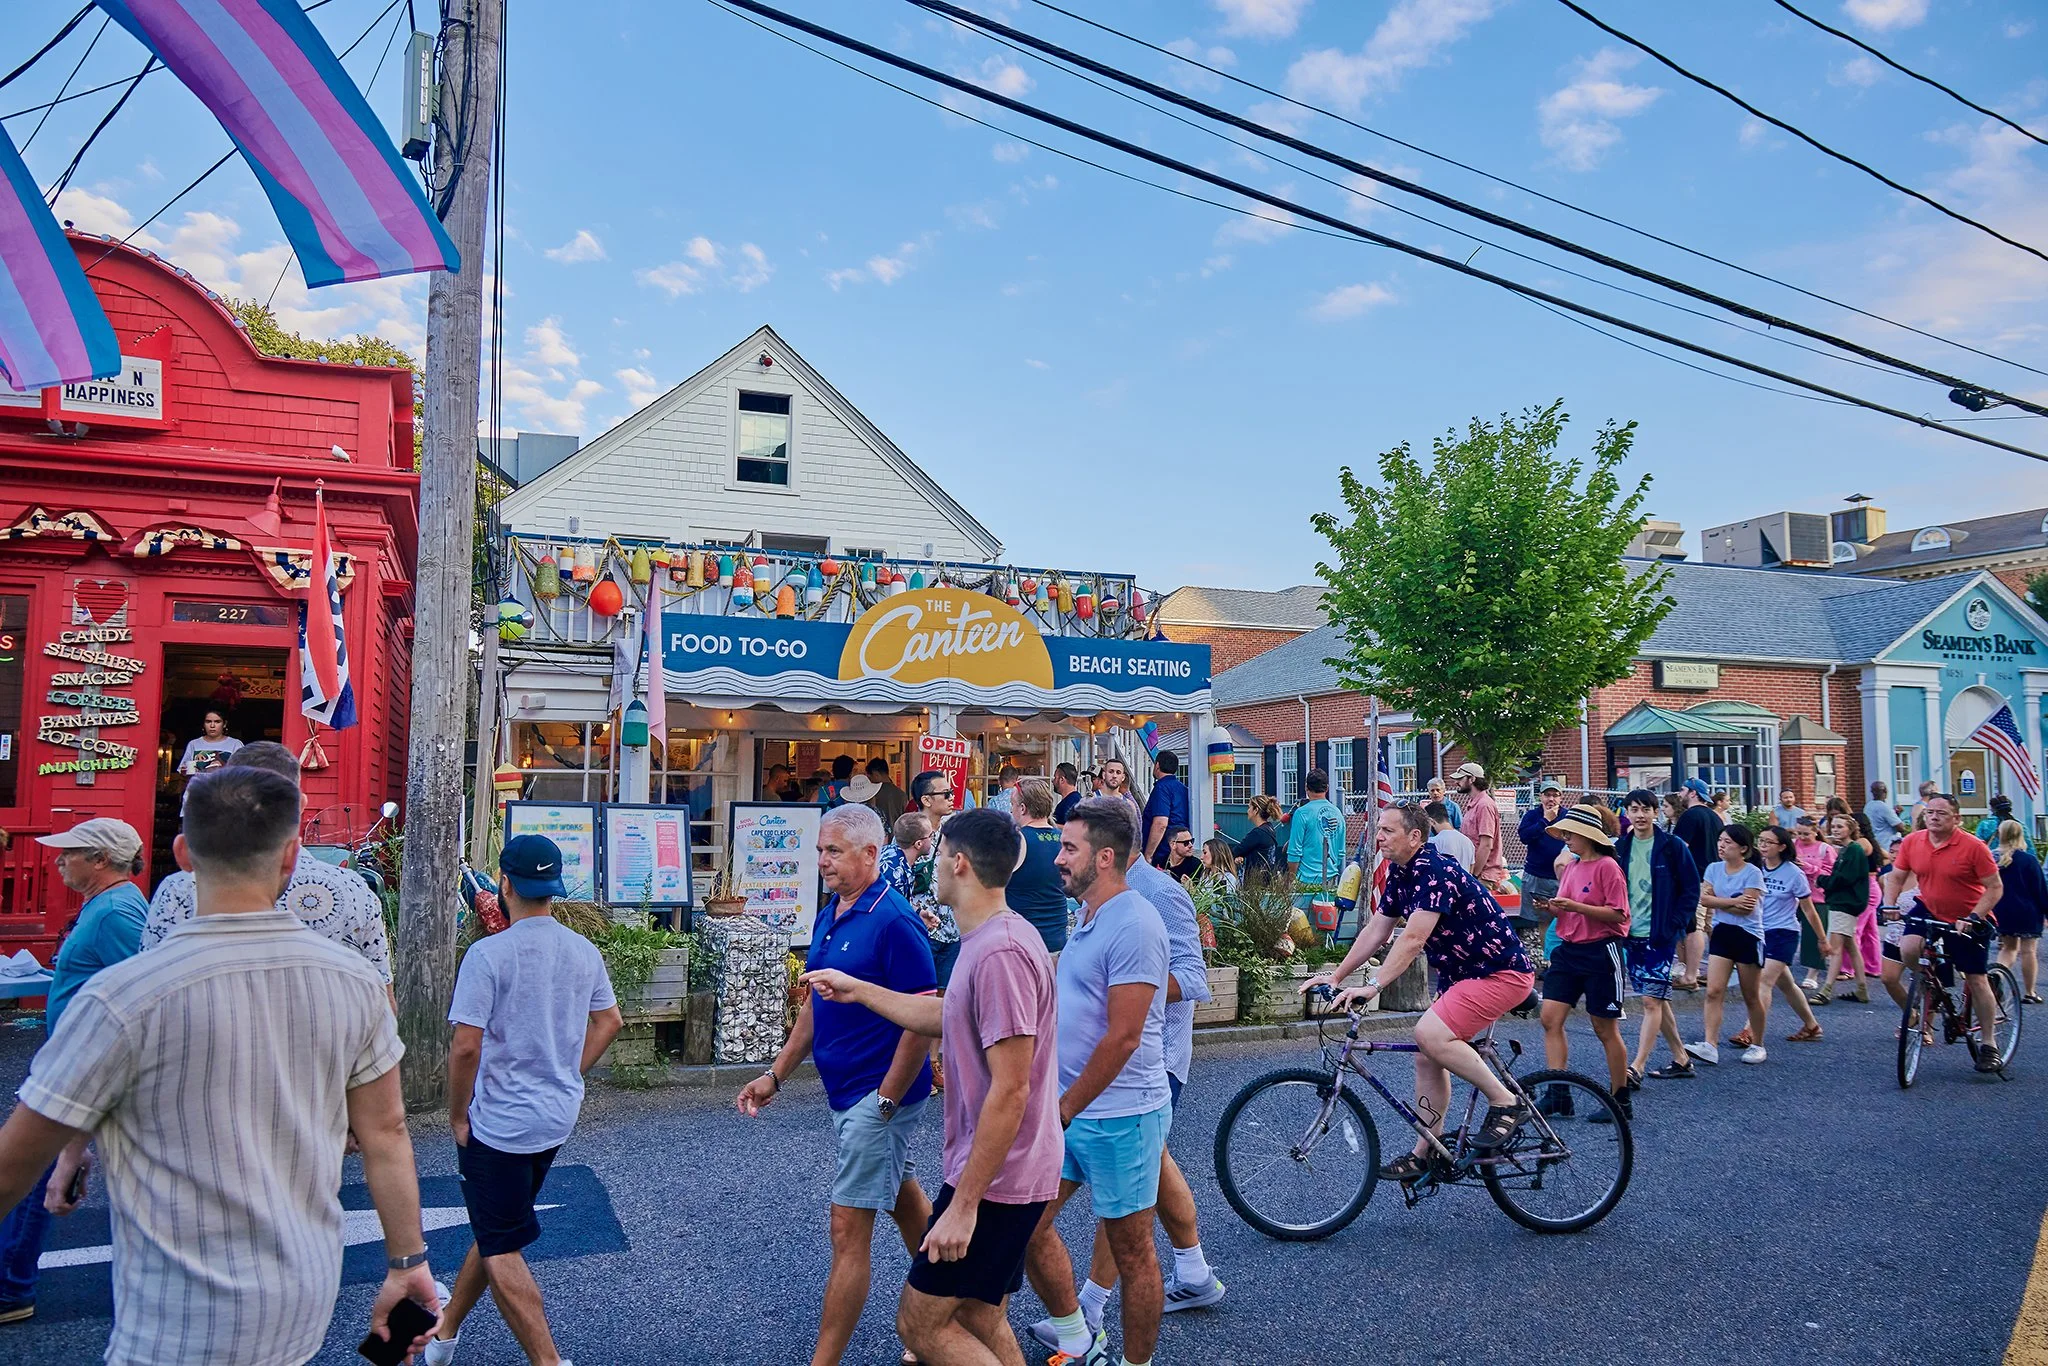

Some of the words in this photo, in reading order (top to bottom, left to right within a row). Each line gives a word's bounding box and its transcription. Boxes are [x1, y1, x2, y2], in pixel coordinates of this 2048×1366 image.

[65, 383, 155, 407] HAPPINESS
[218, 607, 248, 620] 227
[926, 599, 951, 613] THE
[60, 629, 131, 643] CANDY
[859, 601, 1024, 678] Canteen
[1923, 629, 1992, 654] SEAMEN'S
[1993, 634, 2037, 655] BANK
[671, 633, 732, 654] FOOD
[738, 637, 807, 659] TO-GO
[47, 642, 142, 673] SLUSHIES
[1069, 655, 1122, 674] BEACH
[1127, 658, 1191, 677] SEATING
[1943, 653, 1984, 661] MEMBER
[1990, 655, 2014, 663] FDIC
[51, 672, 131, 686] SNACKS
[50, 691, 131, 711] COFFEE
[40, 711, 139, 730] BANANAS
[38, 730, 76, 747] POP
[81, 738, 137, 760] CORN
[922, 737, 965, 754] OPEN
[38, 757, 130, 775] MUNCHIES
[928, 753, 963, 769] BEACH
[759, 814, 788, 827] Canteen
